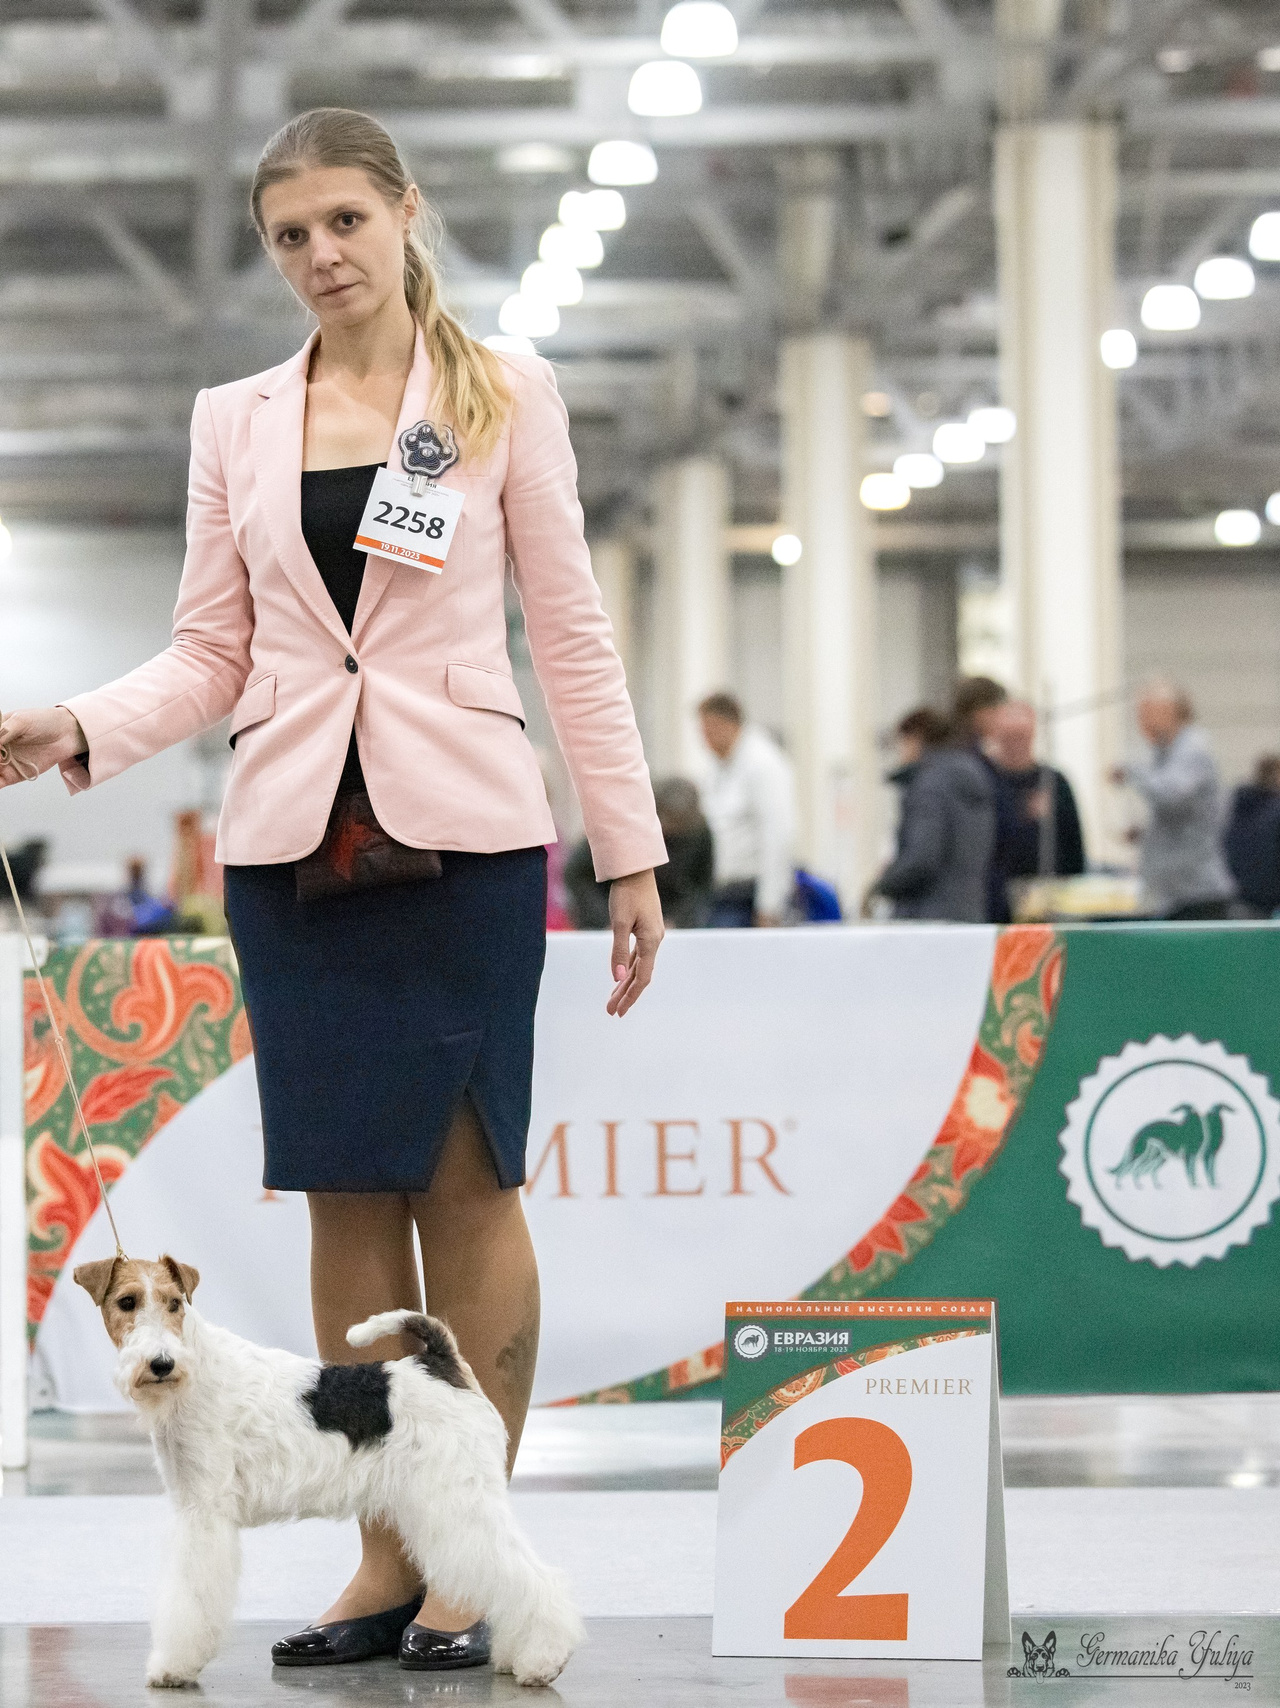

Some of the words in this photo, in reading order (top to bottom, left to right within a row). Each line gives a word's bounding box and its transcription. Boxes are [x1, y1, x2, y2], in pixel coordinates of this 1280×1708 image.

[373, 501, 446, 539] 2258
[380, 542, 421, 560] 19.11.2023
[736, 1305, 850, 1314] НАЦИОНАЛЬНЫЕ
[859, 1305, 932, 1313] ВЫСТАВКИ
[941, 1305, 986, 1313] СОБАК
[773, 1332, 849, 1345] ЕВРАЗИЯ
[865, 1378, 972, 1395] PREMIER
[783, 1416, 913, 1641] 2
